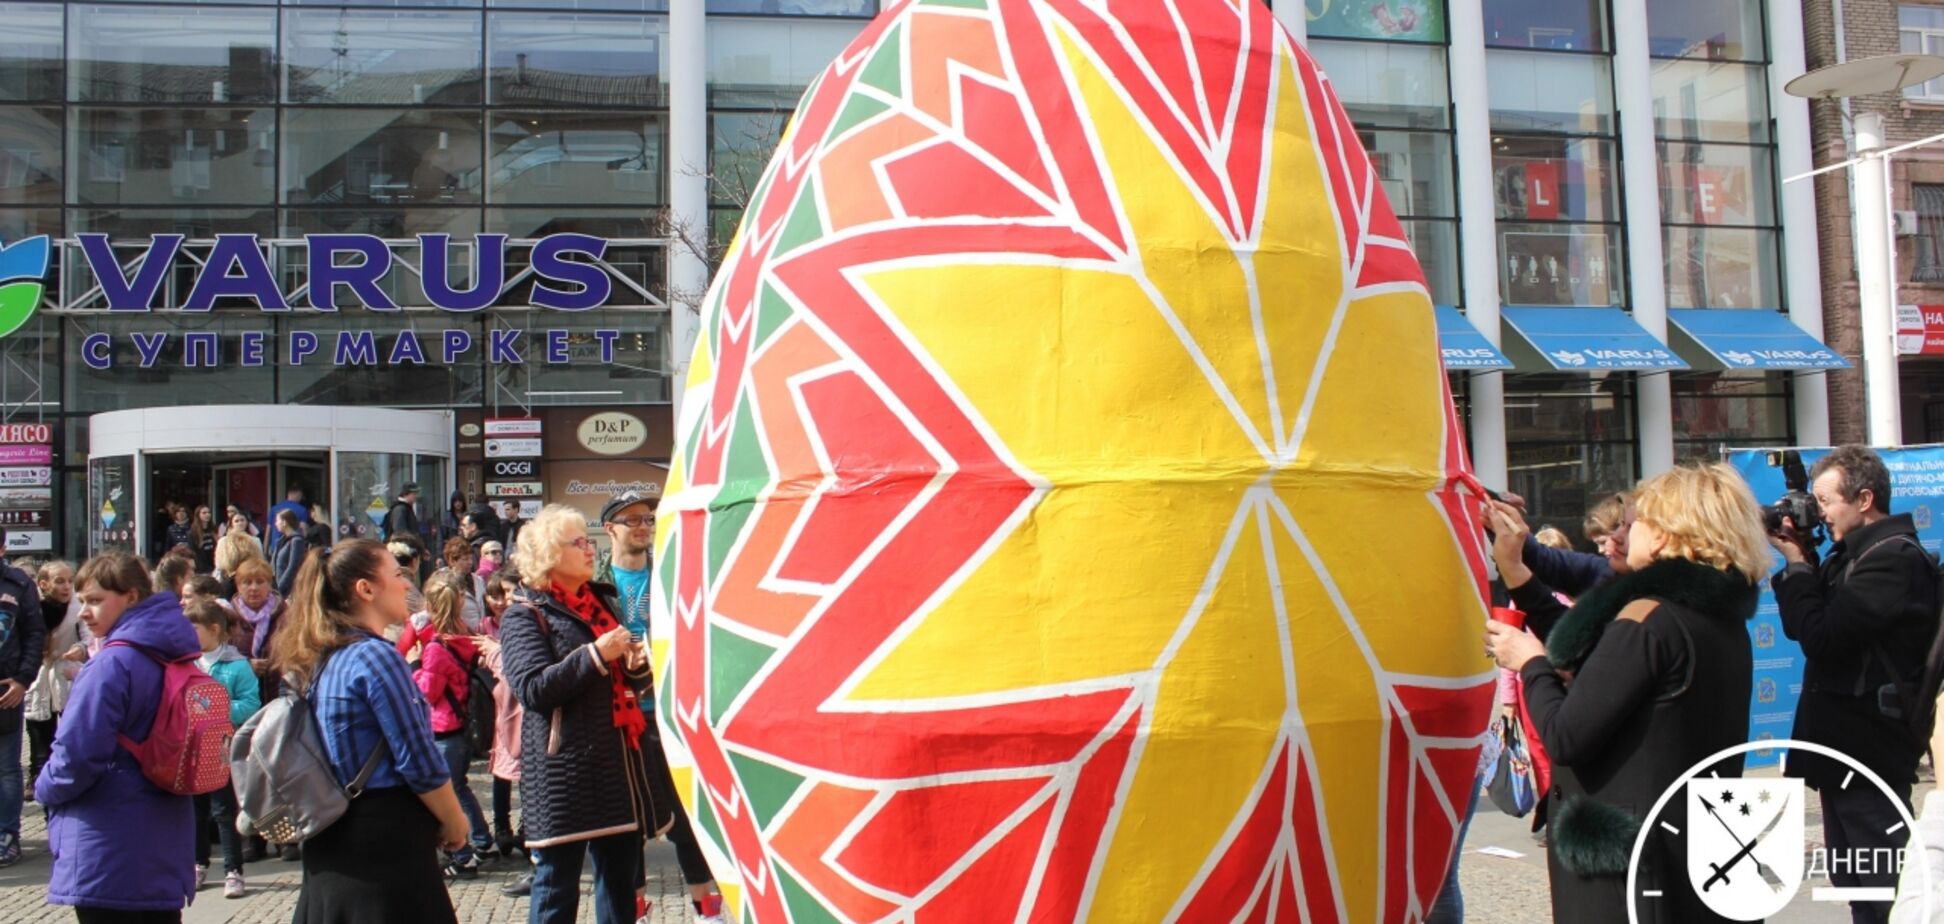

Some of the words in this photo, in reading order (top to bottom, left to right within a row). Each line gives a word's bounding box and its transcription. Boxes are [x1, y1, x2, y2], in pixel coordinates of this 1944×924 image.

[74, 233, 612, 312] VARUS
[81, 329, 619, 369] СУПЕРМАРКЕТ
[1584, 348, 1670, 359] VARUS
[1751, 349, 1833, 359] VARUS
[594, 419, 630, 433] D&P
[494, 461, 531, 475] OGGI
